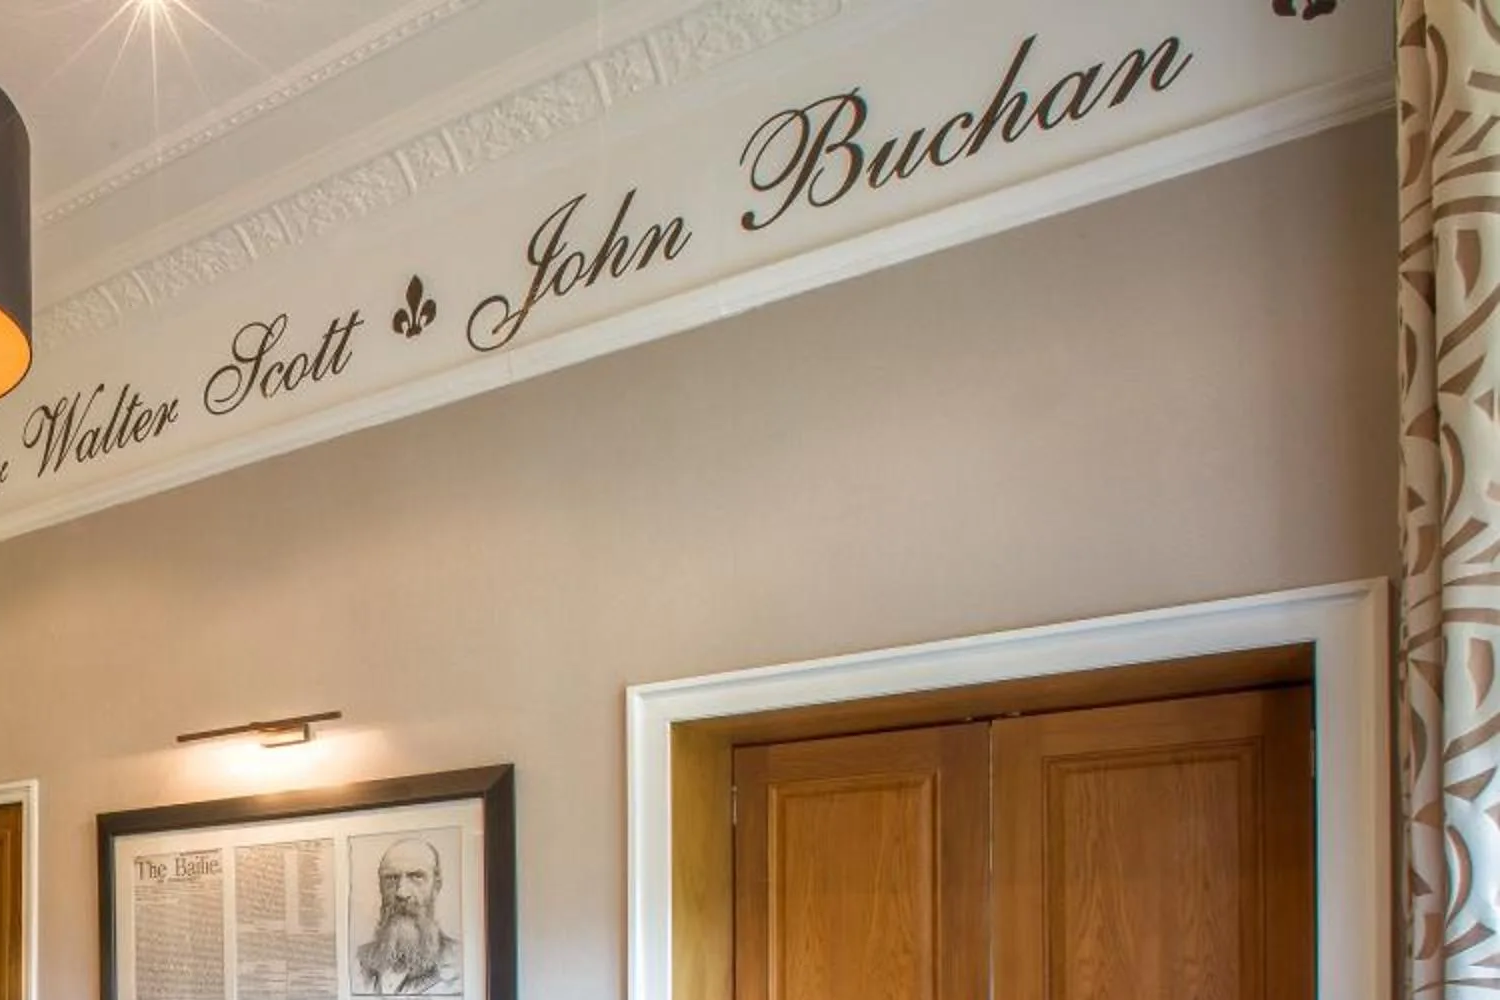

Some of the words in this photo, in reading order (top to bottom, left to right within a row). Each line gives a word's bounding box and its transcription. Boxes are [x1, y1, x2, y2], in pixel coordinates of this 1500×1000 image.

[466, 188, 692, 352] John
[739, 34, 1194, 231] Buchan
[23, 383, 179, 478] Walter
[203, 309, 364, 416] Scott
[134, 857, 167, 881] The
